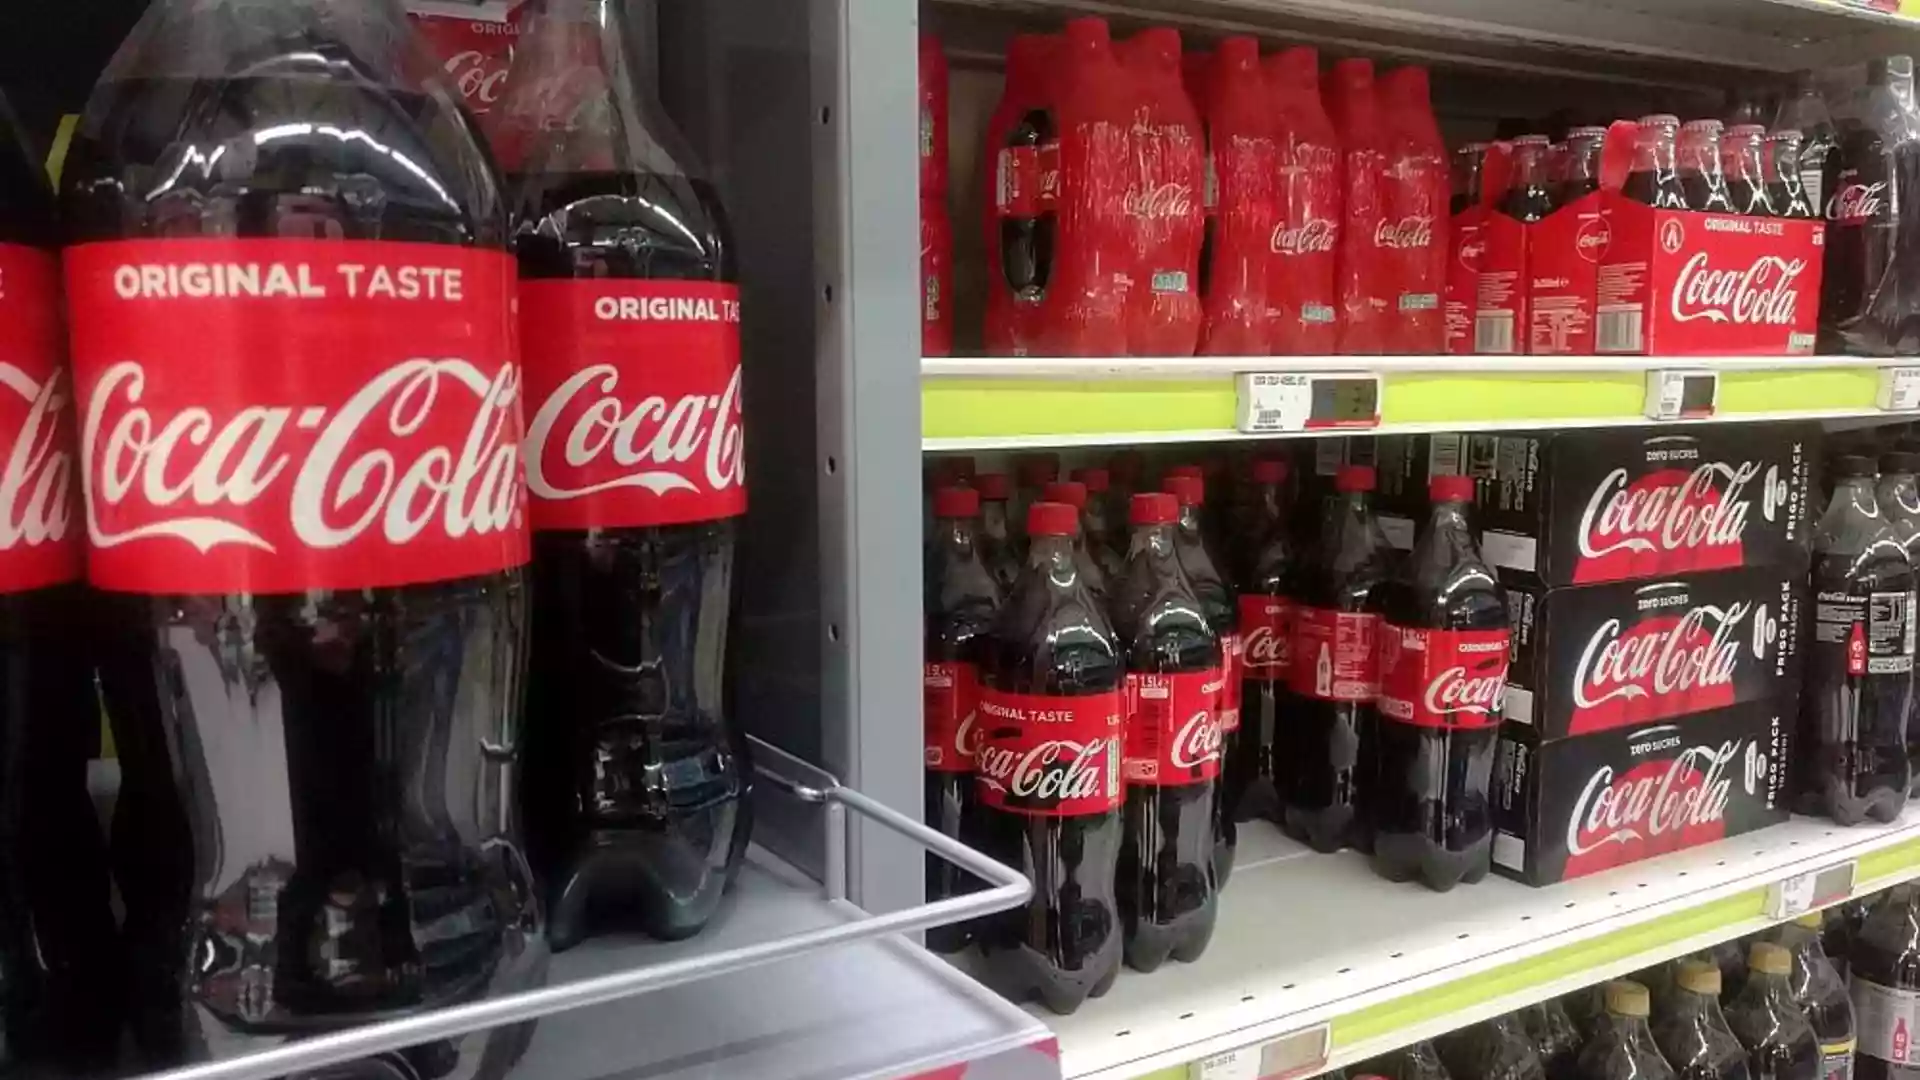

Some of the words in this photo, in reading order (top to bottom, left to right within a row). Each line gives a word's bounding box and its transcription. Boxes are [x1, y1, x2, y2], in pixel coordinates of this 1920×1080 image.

[1271, 217, 1340, 254] Coca-Cola
[115, 265, 325, 299] ORIGINAL
[345, 267, 463, 300] TASTE
[1672, 252, 1806, 325] Coca-Cola
[595, 296, 719, 321] ORIGINAL
[84, 359, 522, 554] Coca-Cola
[1791, 442, 1802, 485] PACK
[1578, 461, 1762, 558] Coca-Cola
[1780, 580, 1791, 622] PACK
[1573, 600, 1751, 708] Coca-Cola
[1027, 710, 1074, 722] TASTE
[1771, 716, 1780, 757] PACK
[1566, 738, 1742, 857] Coca-Cola
